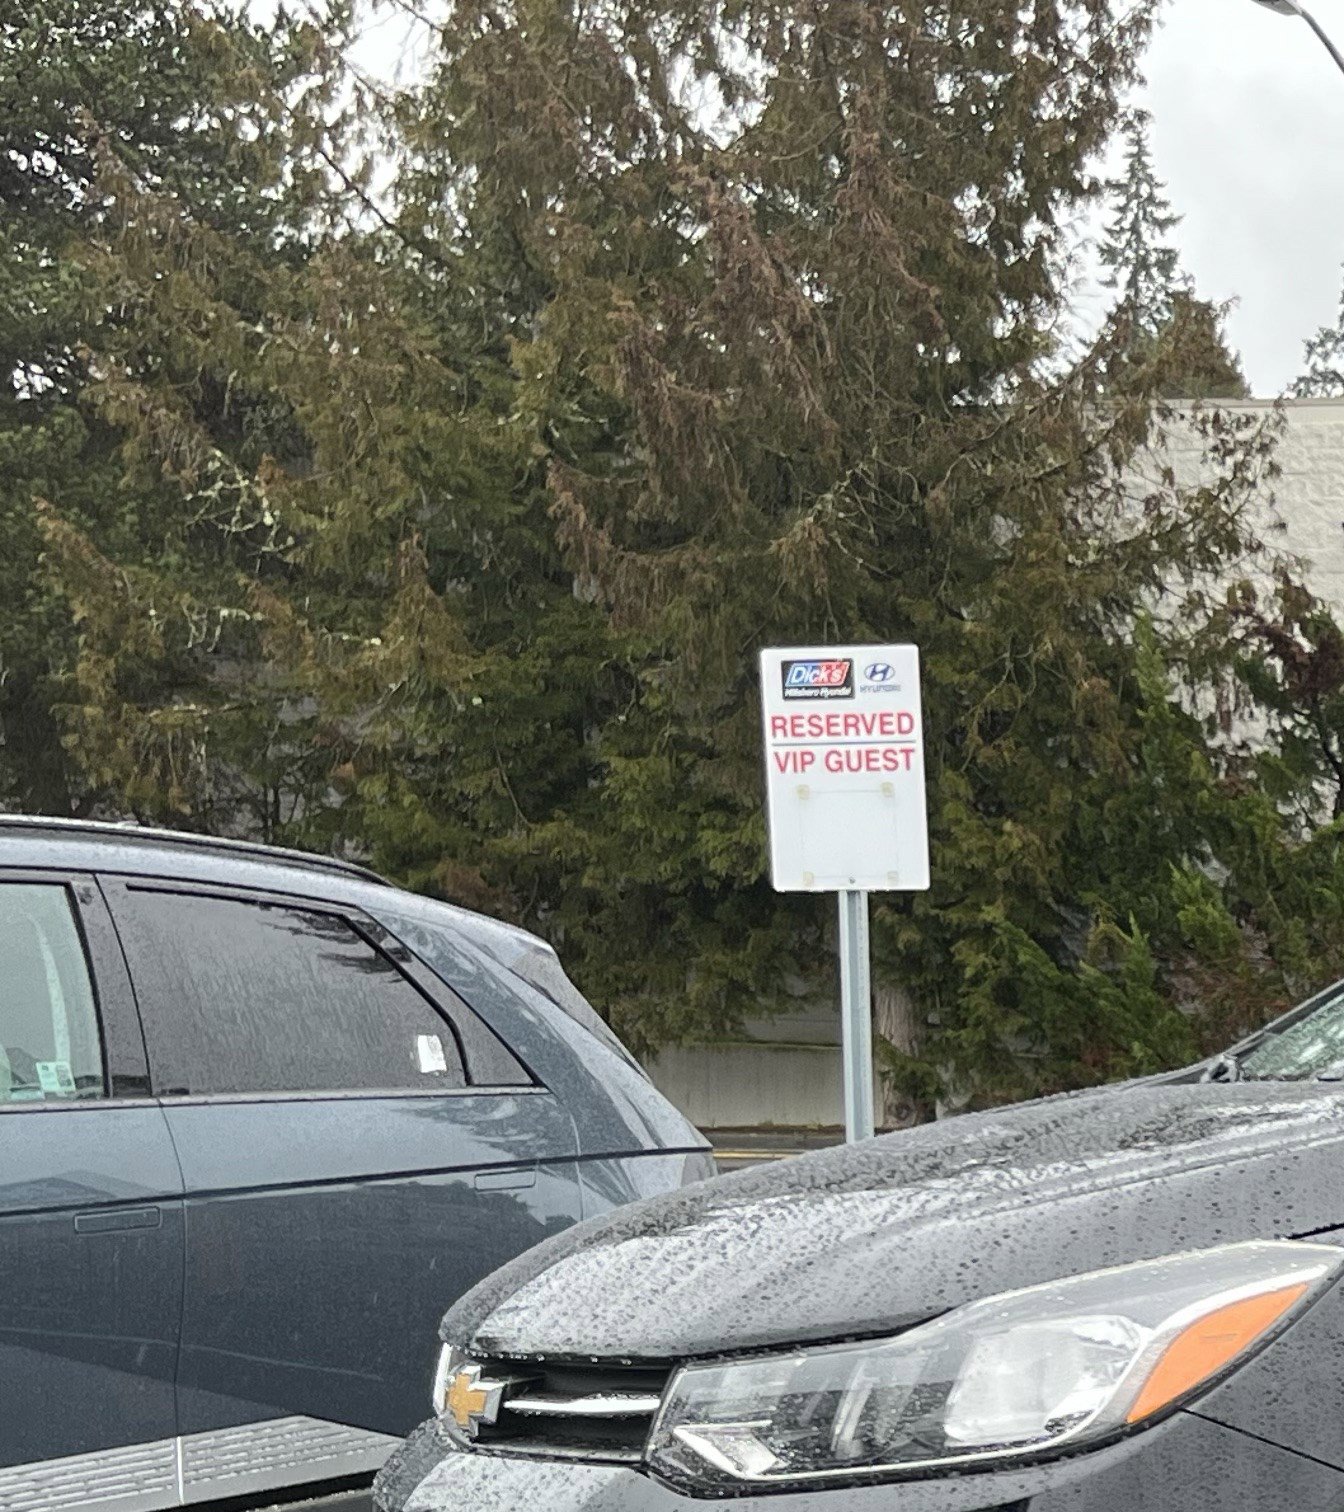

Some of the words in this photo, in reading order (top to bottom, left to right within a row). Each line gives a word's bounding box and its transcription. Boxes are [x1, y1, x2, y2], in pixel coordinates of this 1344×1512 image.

[771, 712, 915, 738] RESERVED
[774, 749, 816, 774] VIP
[824, 748, 916, 773] GUEST
